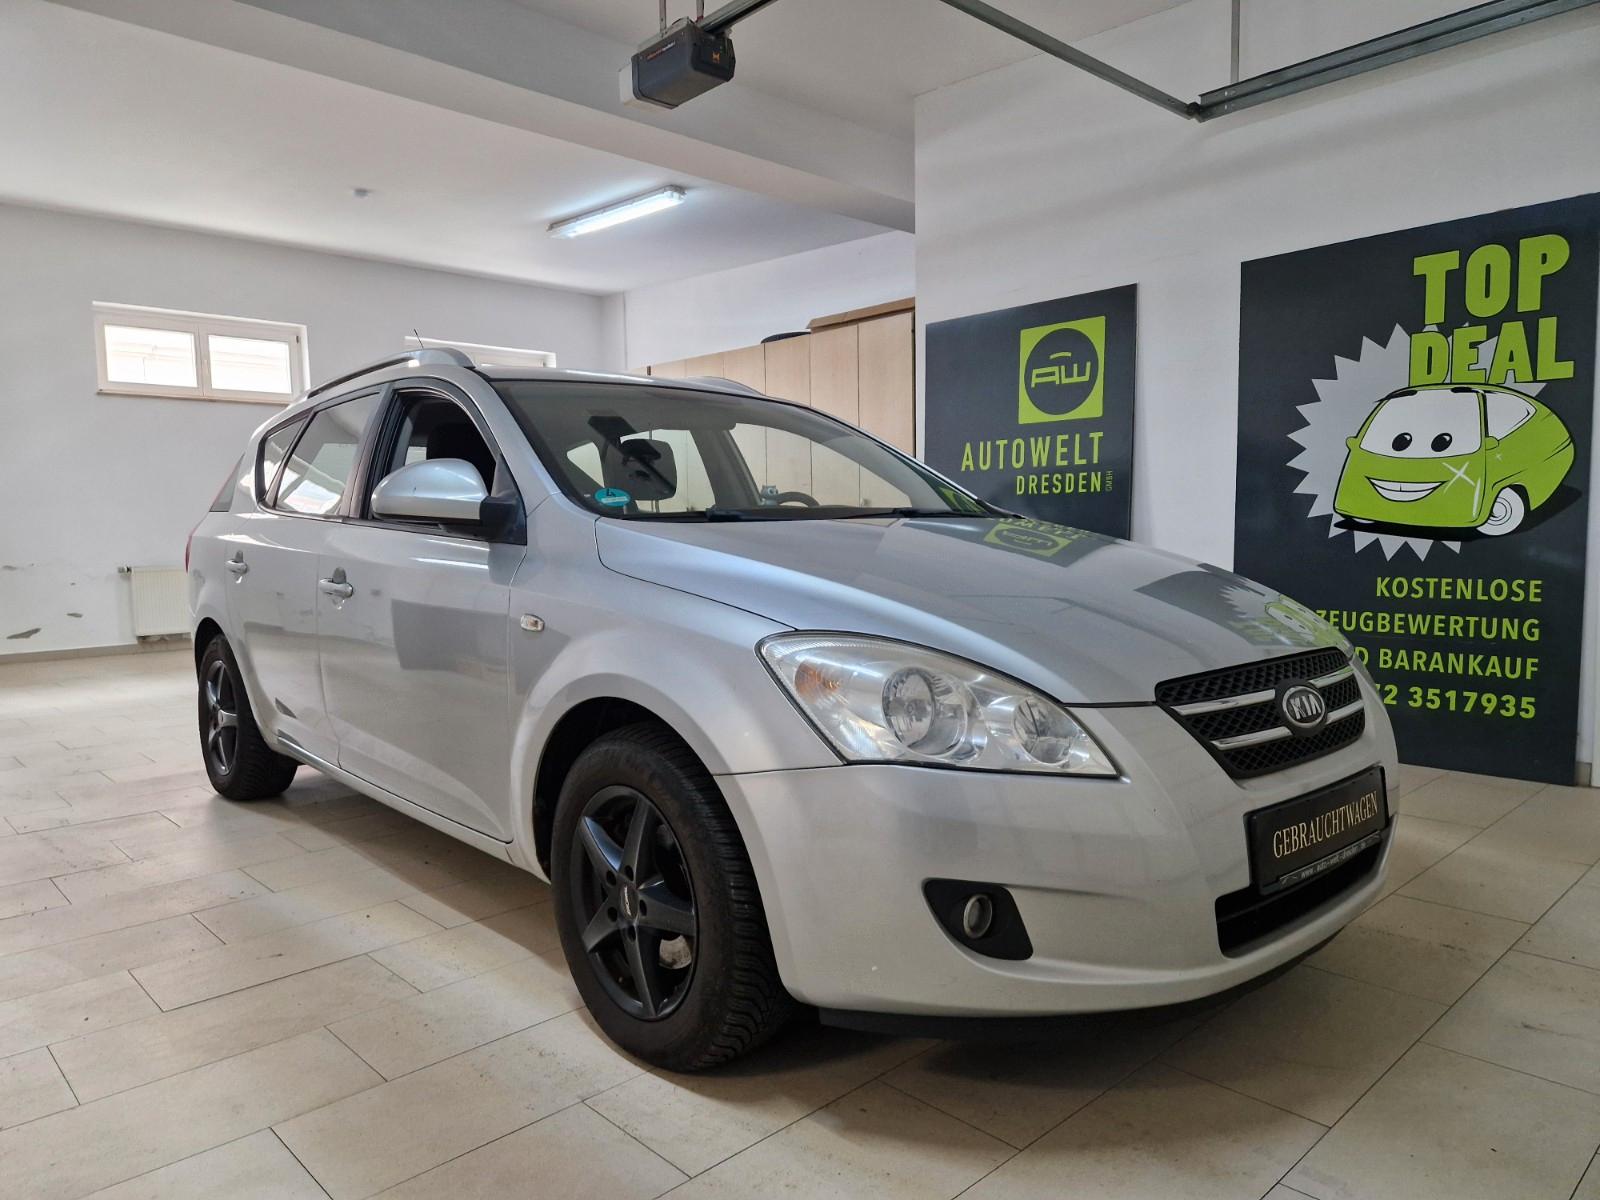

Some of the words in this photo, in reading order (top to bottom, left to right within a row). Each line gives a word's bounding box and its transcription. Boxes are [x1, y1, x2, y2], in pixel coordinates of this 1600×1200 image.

[1413, 234, 1570, 325] TOP
[1408, 316, 1575, 388] DEAL
[961, 432, 1104, 472] AUTOWELT
[1016, 472, 1101, 495] DRESDEN
[1376, 576, 1542, 602] KOSTENLOSE
[1379, 649, 1539, 680] BARANKAUF
[1290, 694, 1322, 720] KIA
[1408, 686, 1536, 719] 3517935
[1273, 791, 1378, 858] GEBRAUCHTWAGEN
